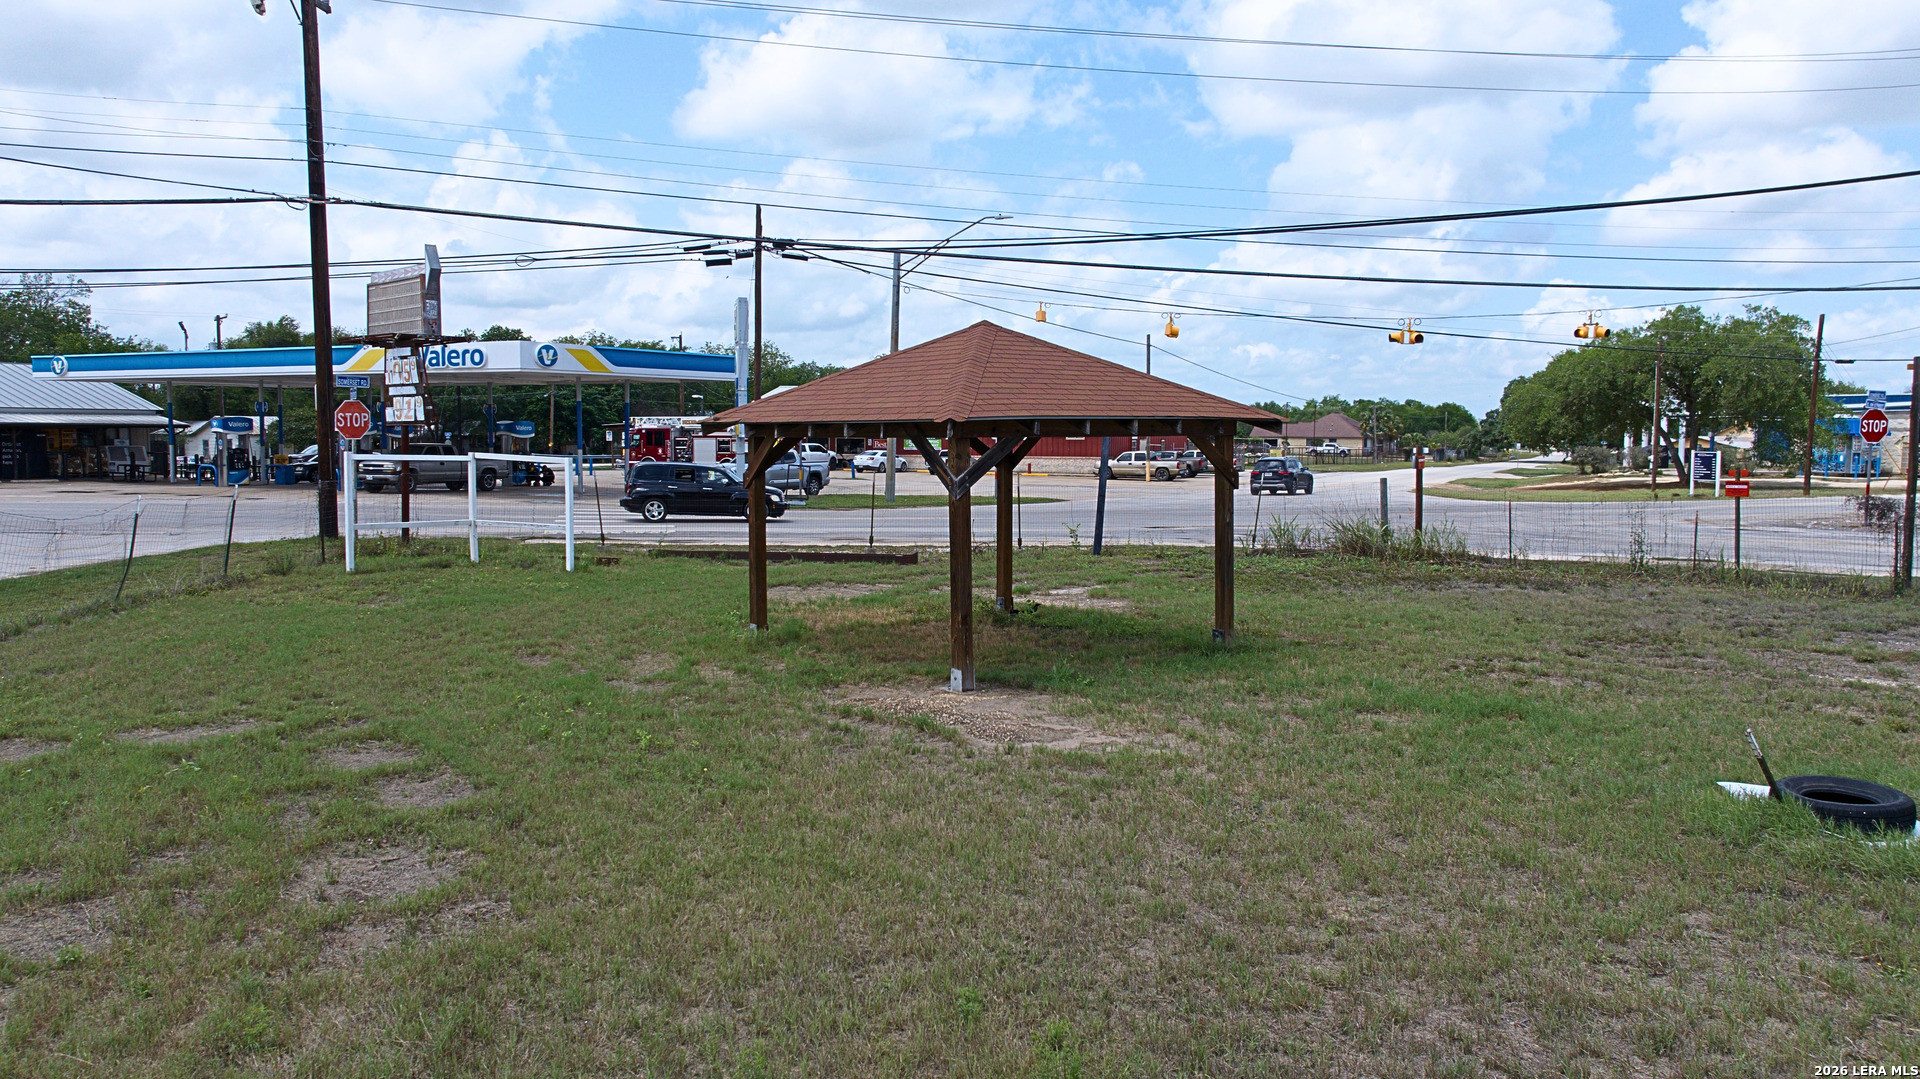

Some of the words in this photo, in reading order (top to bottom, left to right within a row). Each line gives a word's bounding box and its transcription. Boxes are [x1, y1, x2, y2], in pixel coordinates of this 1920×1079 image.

[417, 345, 485, 368] Valero
[337, 377, 360, 386] SOMERSET
[337, 412, 369, 427] STOP
[1861, 419, 1887, 433] STOP
